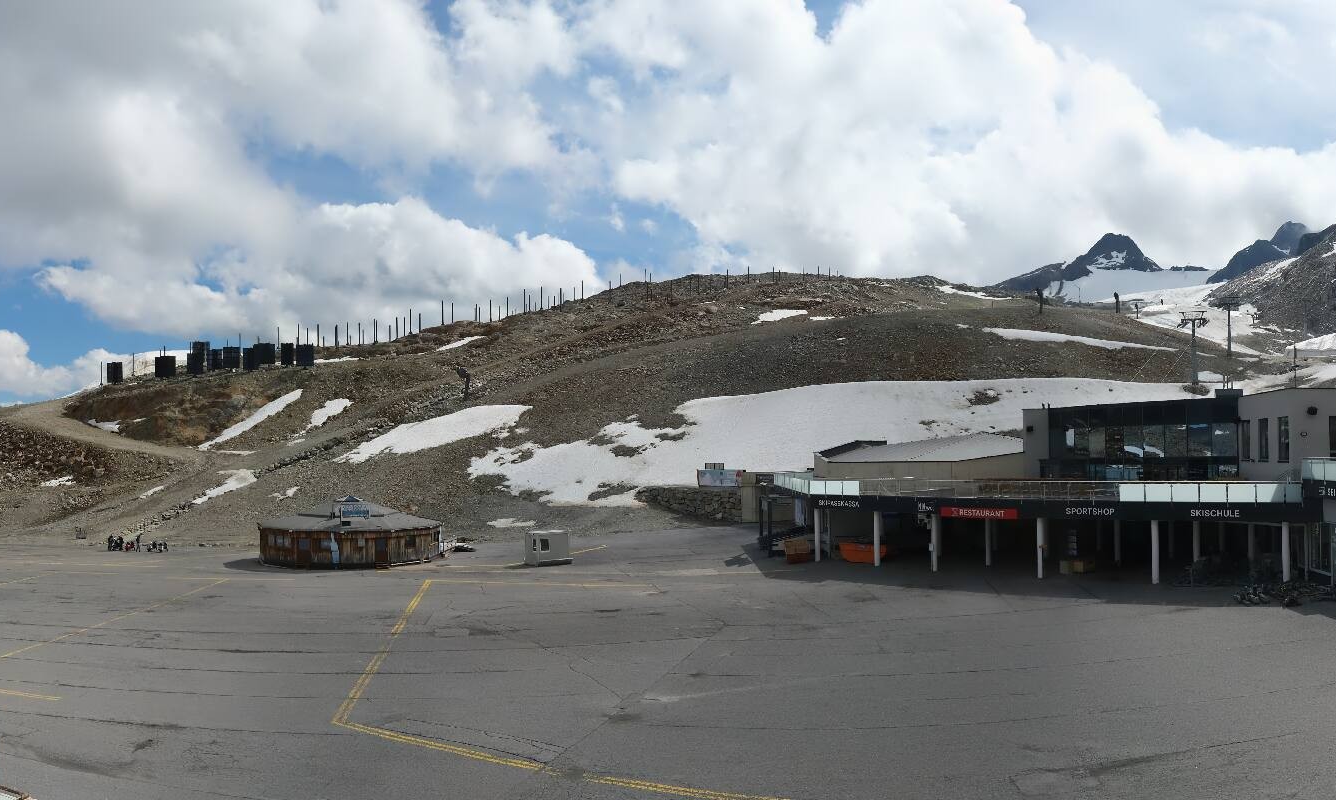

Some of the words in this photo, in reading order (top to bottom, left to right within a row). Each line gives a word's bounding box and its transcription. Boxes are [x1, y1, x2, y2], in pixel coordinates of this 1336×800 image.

[959, 508, 1005, 518] RESTAURANT
[1065, 507, 1115, 516] SPORTSHOP
[1190, 508, 1240, 518] SKISCHULE
